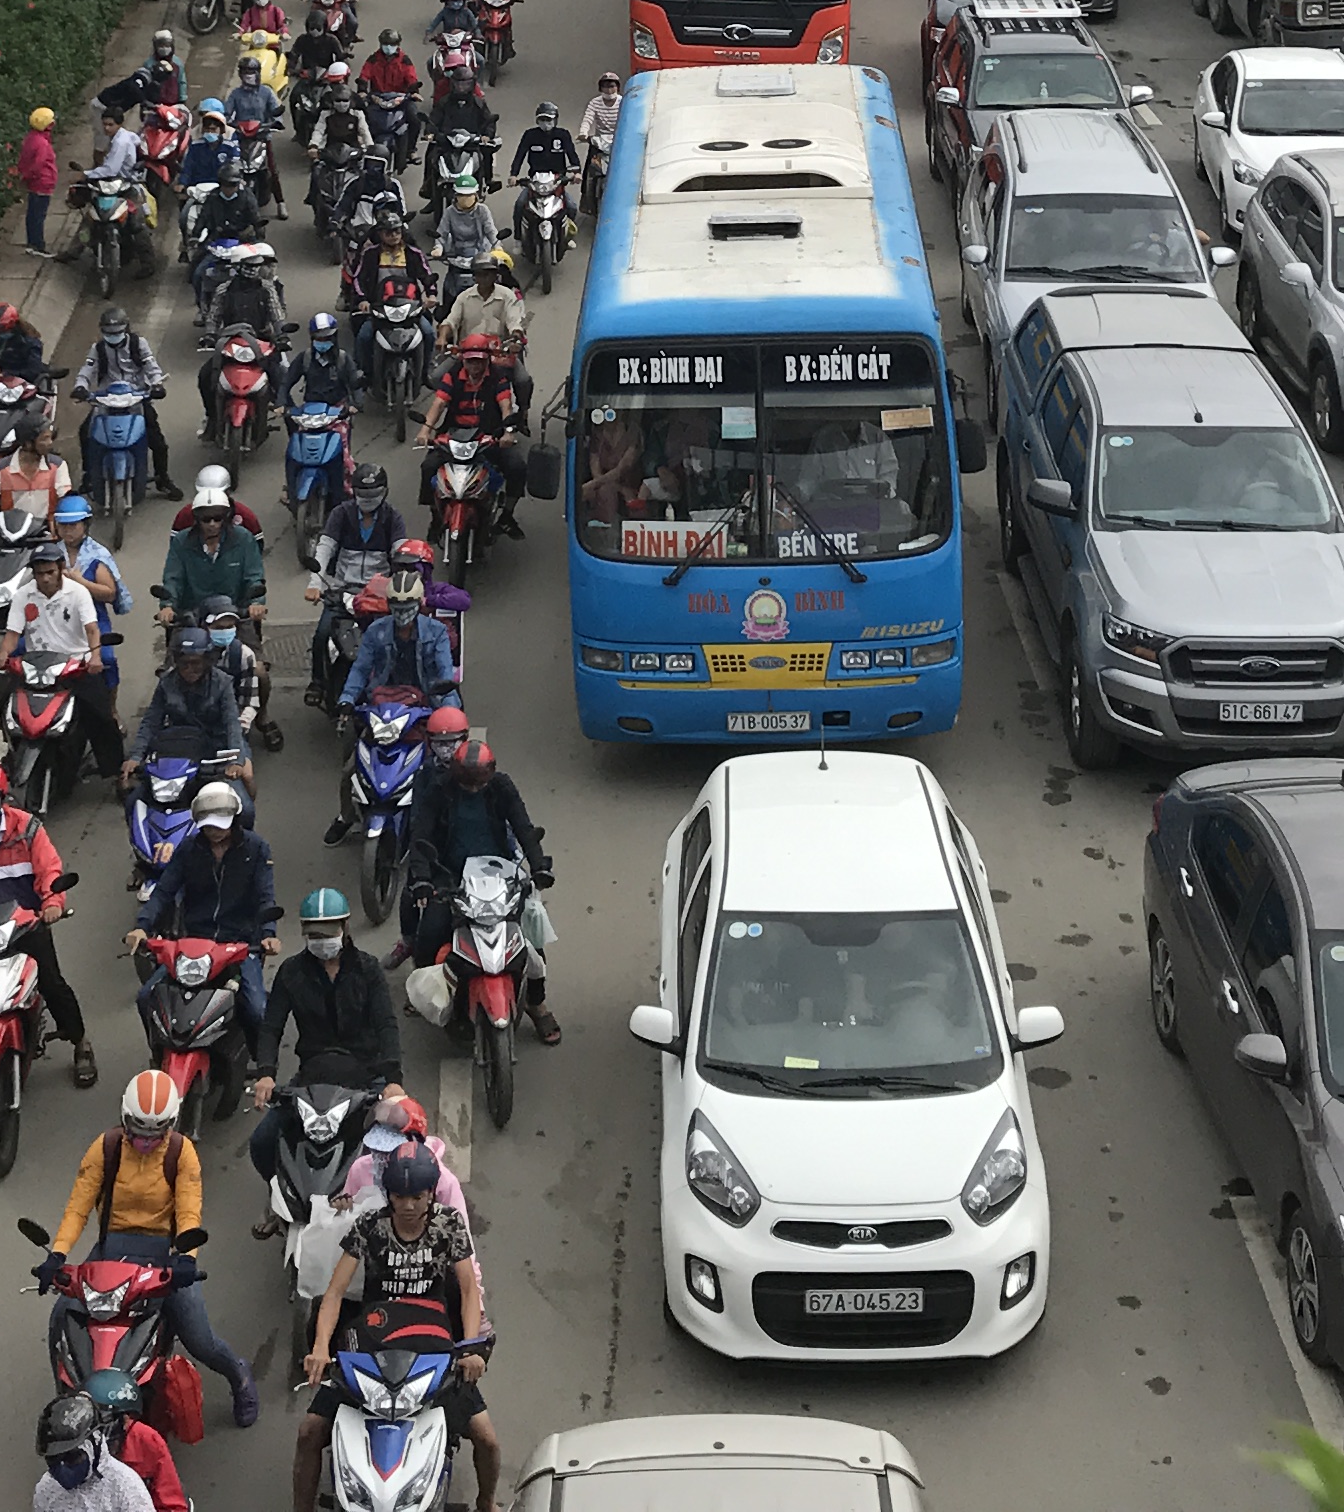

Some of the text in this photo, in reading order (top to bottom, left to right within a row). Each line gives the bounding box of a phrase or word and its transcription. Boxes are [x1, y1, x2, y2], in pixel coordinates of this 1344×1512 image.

[694, 356, 723, 389] ĐẠI
[857, 345, 892, 381] CÁT
[624, 523, 678, 559] BÌNH
[777, 529, 817, 559] BẾN
[688, 589, 731, 614] HÒA
[794, 587, 845, 613] BÌNH
[1222, 703, 1301, 720] 51C-661.47
[852, 1229, 873, 1239] KIA
[809, 1292, 920, 1312] 67A-045.23
